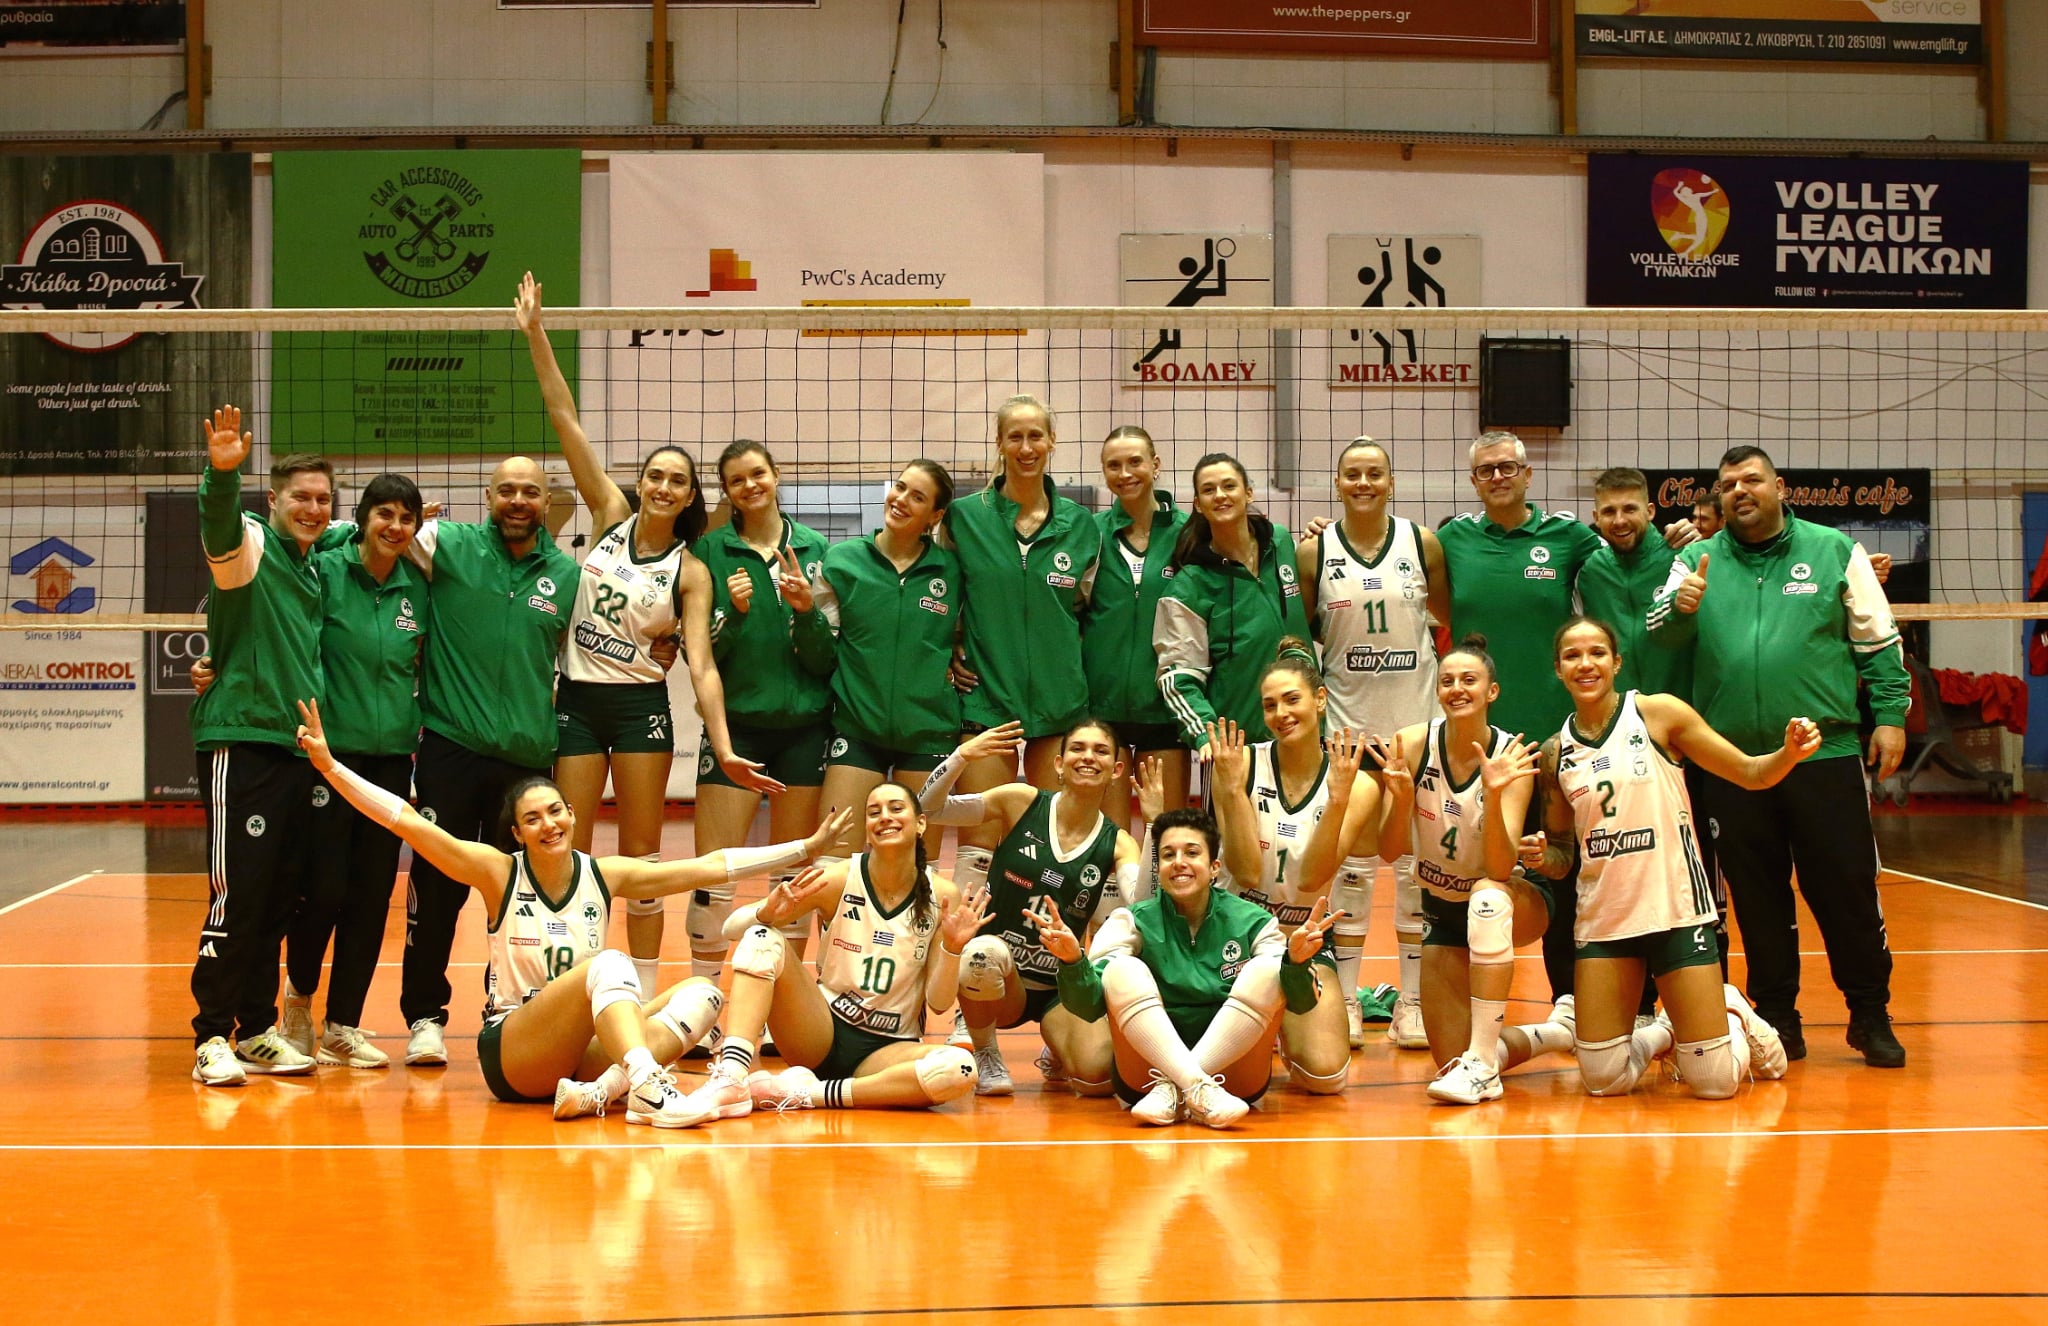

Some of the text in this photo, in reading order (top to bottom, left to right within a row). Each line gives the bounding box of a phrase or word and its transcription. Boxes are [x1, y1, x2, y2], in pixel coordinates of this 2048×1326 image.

[1272, 5, 1412, 22] www.thepeppers.gr
[1674, 31, 1741, 46] ΔΗΜΟΚΡΑΤΙΑΣ
[1828, 35, 1845, 48] 210
[1848, 36, 1886, 49] 2851091
[1893, 38, 1968, 54] www.emgllift.gr
[370, 167, 483, 207] CAR ACCESSORIES
[1775, 181, 1939, 211] VOLLEY
[58, 206, 123, 224] EST. 1981
[359, 224, 494, 238] AUTO PARTS
[1776, 214, 1942, 243] LEAGUE
[1630, 252, 1740, 267] VOLLEYLEAGUE
[1776, 246, 1991, 276] ΓΥΝΑΙΚΩΝ
[379, 266, 474, 297] MARAGKOS
[801, 268, 947, 289] PwC's Academy
[1644, 265, 1717, 278] ΓΥΝΑΙΚΩΝ
[1775, 286, 1802, 297] FOLLOW
[1339, 363, 1472, 383] ΜΠΑΣΚΕΤ
[6, 383, 33, 394] Some
[34, 382, 65, 396] people
[85, 382, 100, 393] the
[101, 382, 125, 393] taste
[126, 382, 136, 395] of
[38, 398, 69, 409] Others
[69, 398, 89, 411] just
[90, 398, 106, 411] get
[592, 583, 628, 626] 22
[1363, 598, 1389, 634] 11
[25, 631, 82, 641] Since 1984
[46, 662, 135, 680] CONTROL
[1597, 780, 1616, 818] 2
[1440, 826, 1457, 861] 4
[1275, 848, 1288, 883] 1
[544, 946, 573, 981] 18
[860, 956, 896, 995] 10
